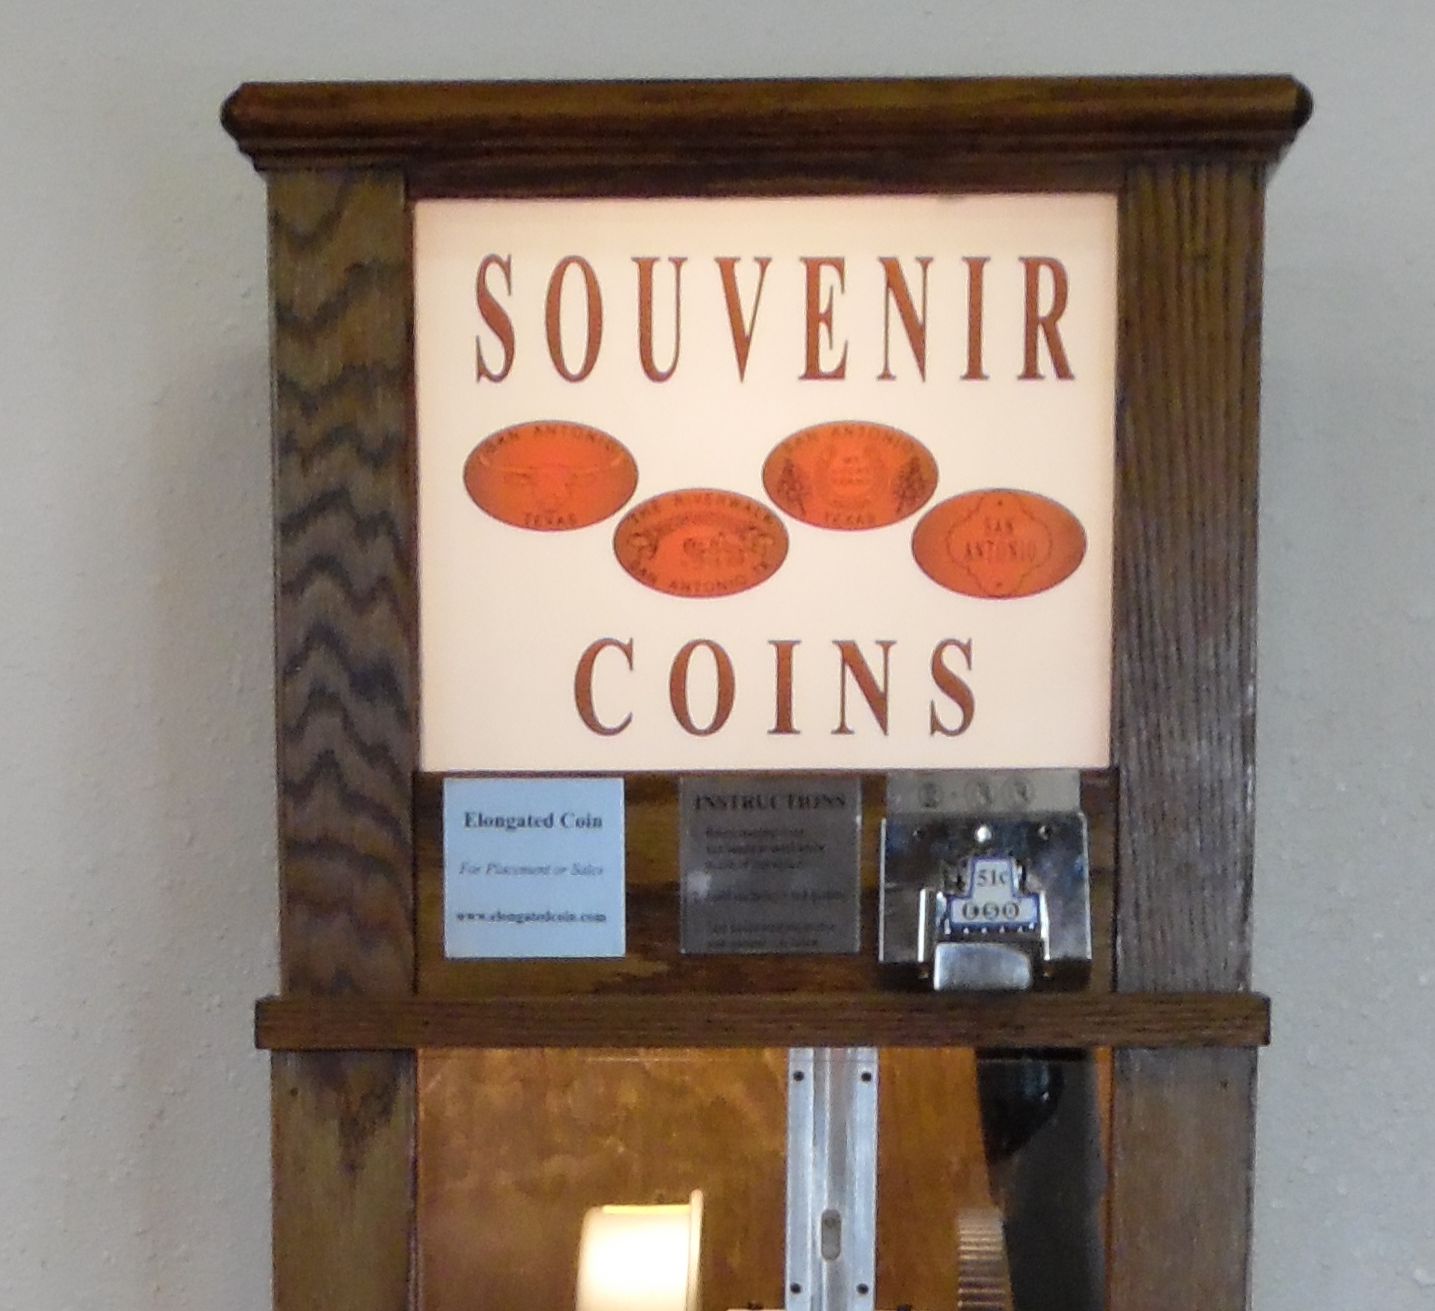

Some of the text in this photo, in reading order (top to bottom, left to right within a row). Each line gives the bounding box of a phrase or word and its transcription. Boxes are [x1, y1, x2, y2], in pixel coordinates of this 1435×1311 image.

[475, 253, 1075, 383] SOUVENIR
[524, 511, 577, 526] TEXAS
[984, 516, 1014, 533] SAN
[964, 540, 1037, 564] ANTONIO
[573, 637, 976, 736] COINS
[694, 793, 845, 810] INSTRUCTIONS
[463, 811, 604, 831] Elongated Coin
[459, 861, 482, 875] For
[486, 861, 551, 876] Placement
[553, 865, 567, 876] or
[456, 910, 607, 924] www.elongatedcoin.com
